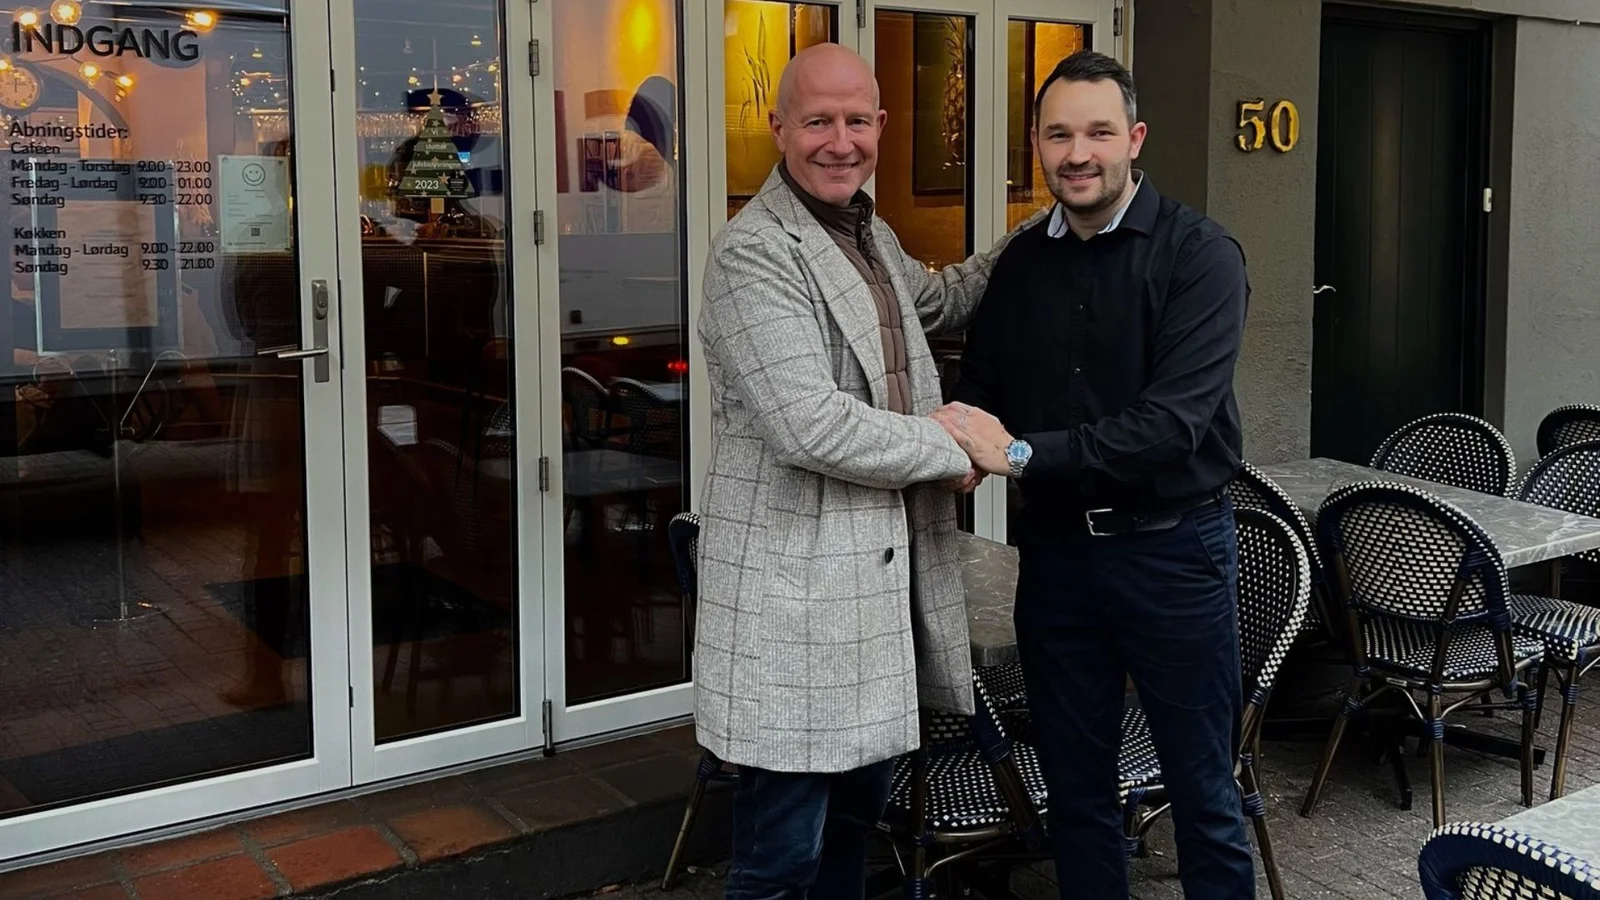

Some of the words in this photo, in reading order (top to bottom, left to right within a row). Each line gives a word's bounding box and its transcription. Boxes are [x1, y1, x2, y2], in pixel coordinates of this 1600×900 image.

[11, 21, 200, 62] INDGANG
[9, 117, 129, 142] Åbningstider:
[1233, 98, 1300, 153] 50
[10, 142, 61, 155] Caféen
[11, 159, 68, 175] Mandag
[79, 160, 131, 175] Torsdag
[137, 160, 166, 173] 9.00
[177, 160, 212, 173] 23.00
[11, 176, 60, 191] Fredag
[71, 176, 118, 191] Lørdag
[139, 177, 167, 189] 9.00
[177, 177, 212, 189] 01.00
[415, 180, 439, 190] 2023
[11, 193, 65, 208] Søndag
[140, 193, 167, 205] 9.30
[177, 193, 213, 205] 22.00
[14, 227, 66, 239] Køkken
[14, 243, 71, 259] Mandag
[83, 243, 129, 257] Lørdag
[141, 242, 168, 254] 9.00
[179, 242, 214, 253] 22.00
[15, 261, 68, 275] Søndag
[142, 259, 168, 271] 9.30
[180, 258, 215, 270] 21.00
